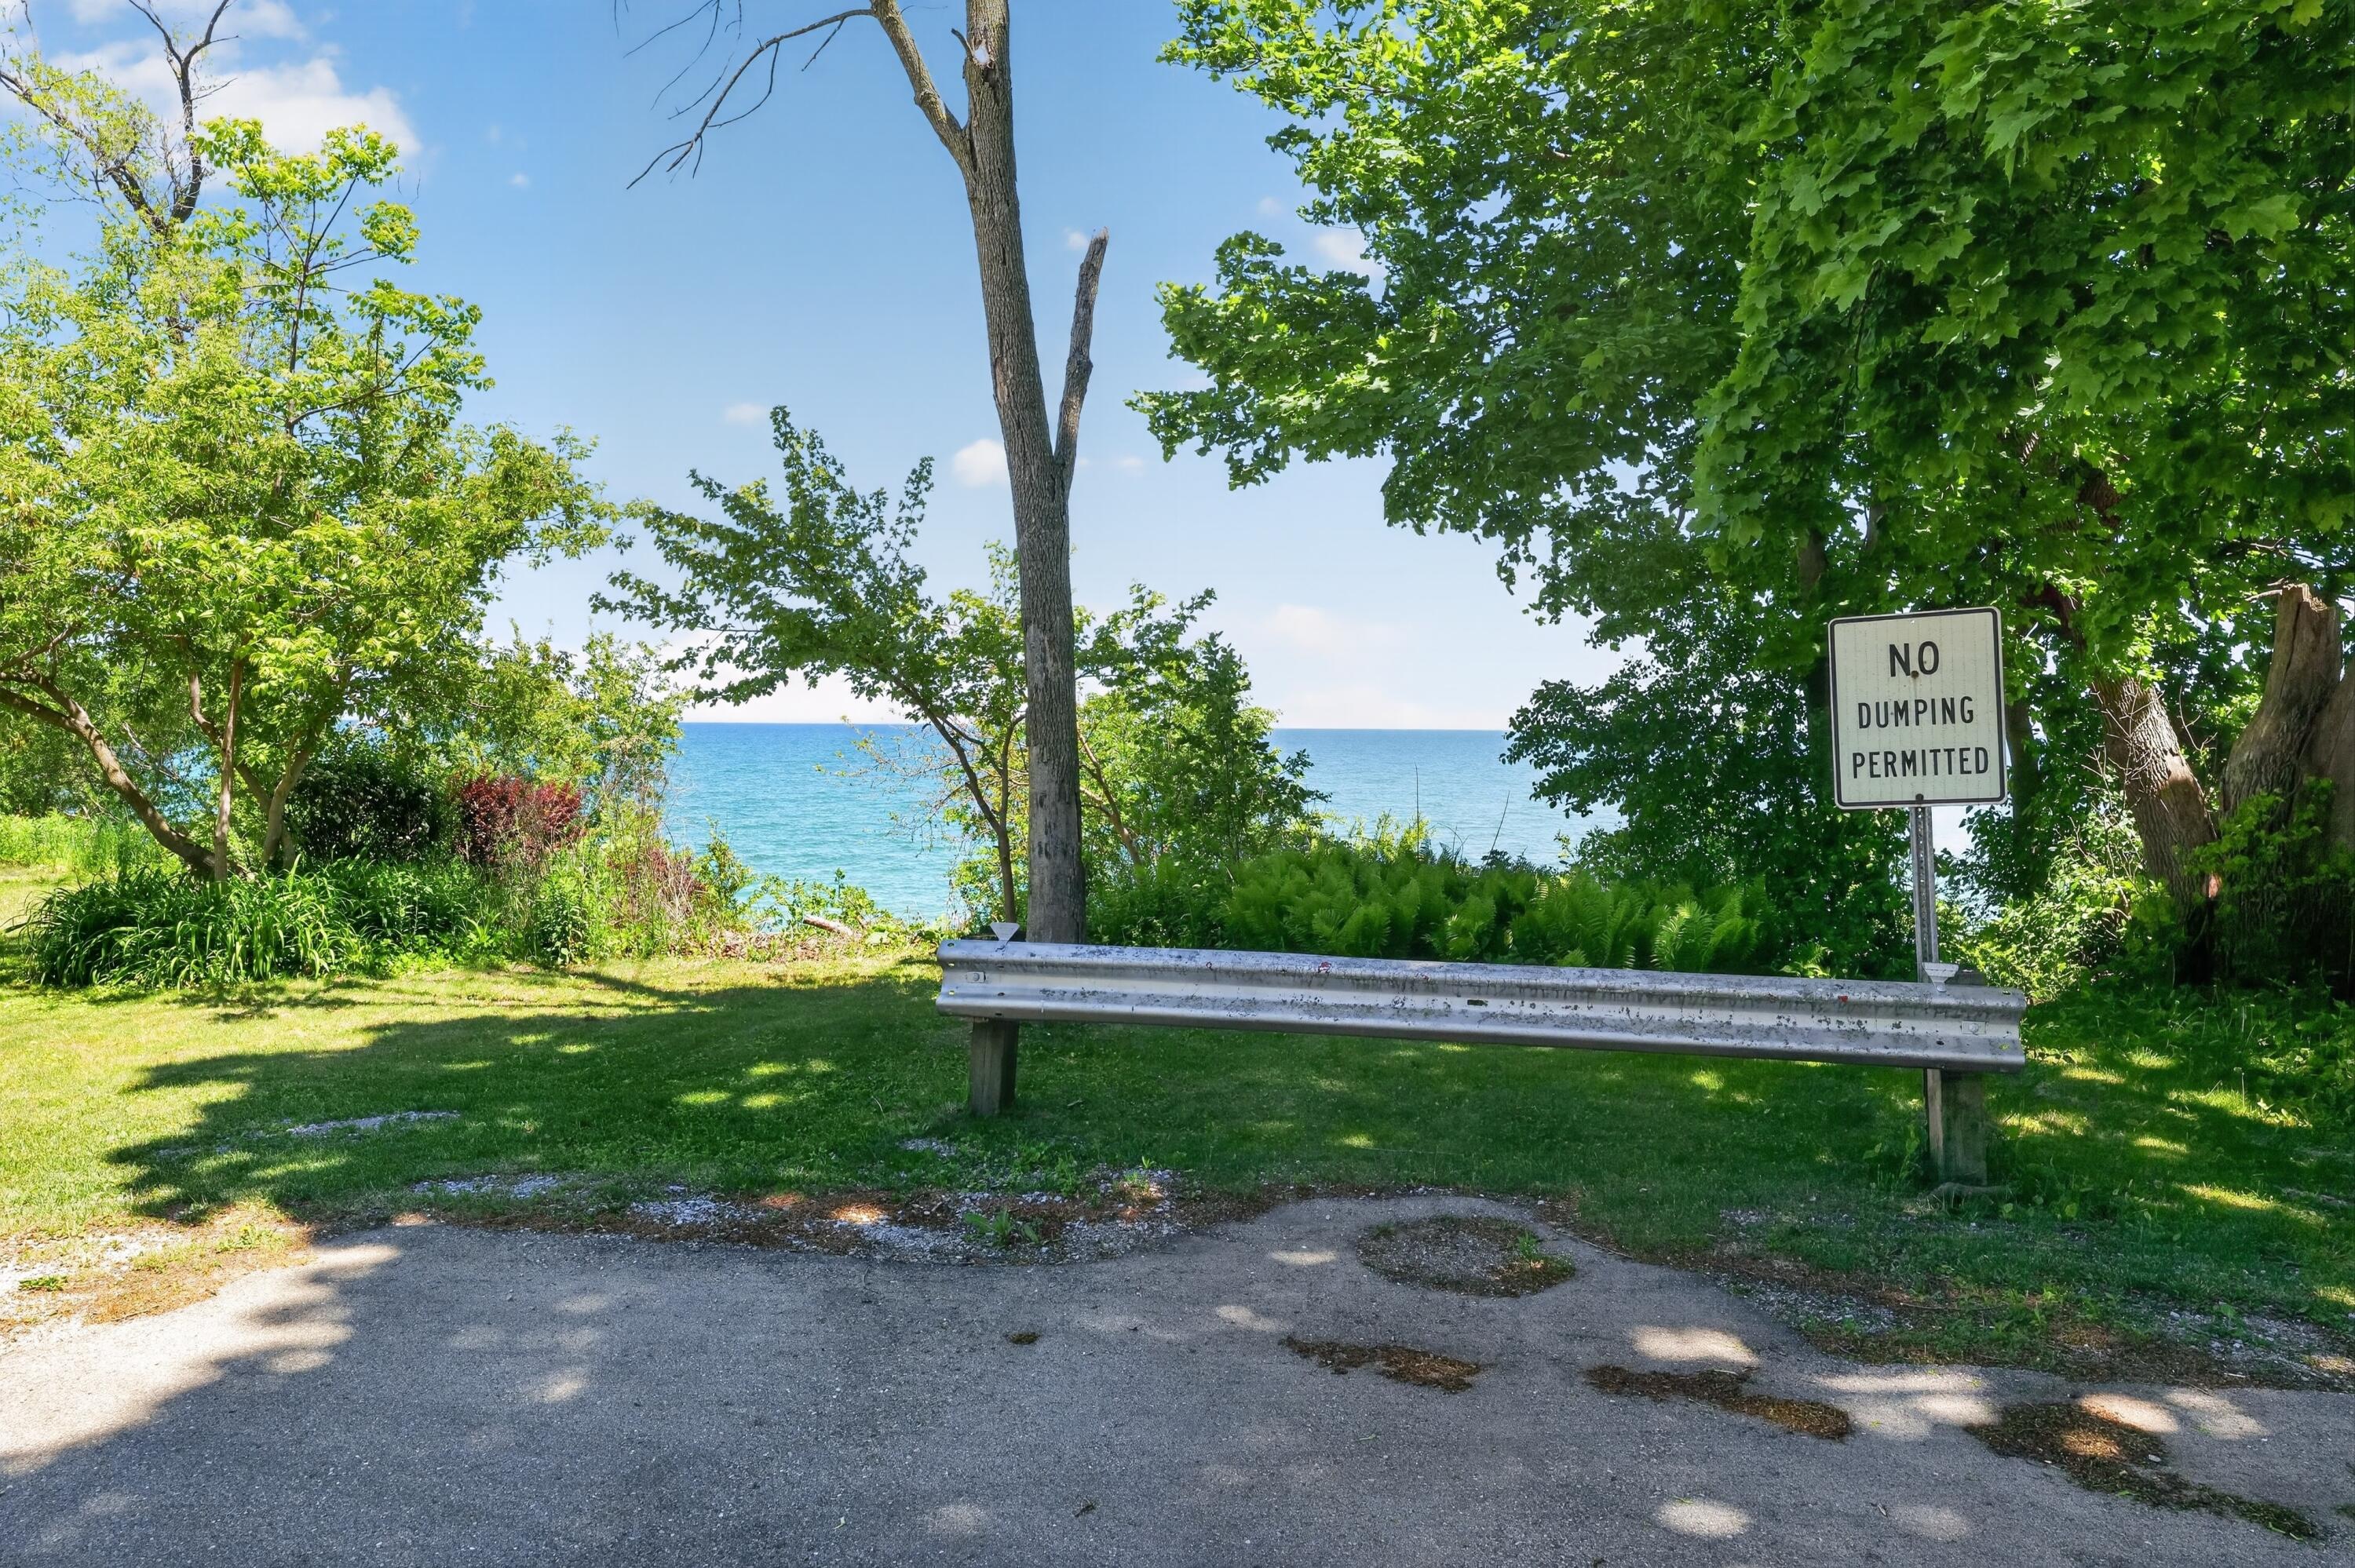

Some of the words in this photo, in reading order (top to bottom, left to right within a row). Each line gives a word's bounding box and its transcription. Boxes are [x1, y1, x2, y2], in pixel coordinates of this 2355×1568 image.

[1889, 641, 1939, 676] NO
[1857, 696, 1973, 729] DUMPING
[1853, 747, 1988, 779] PERMITTED
